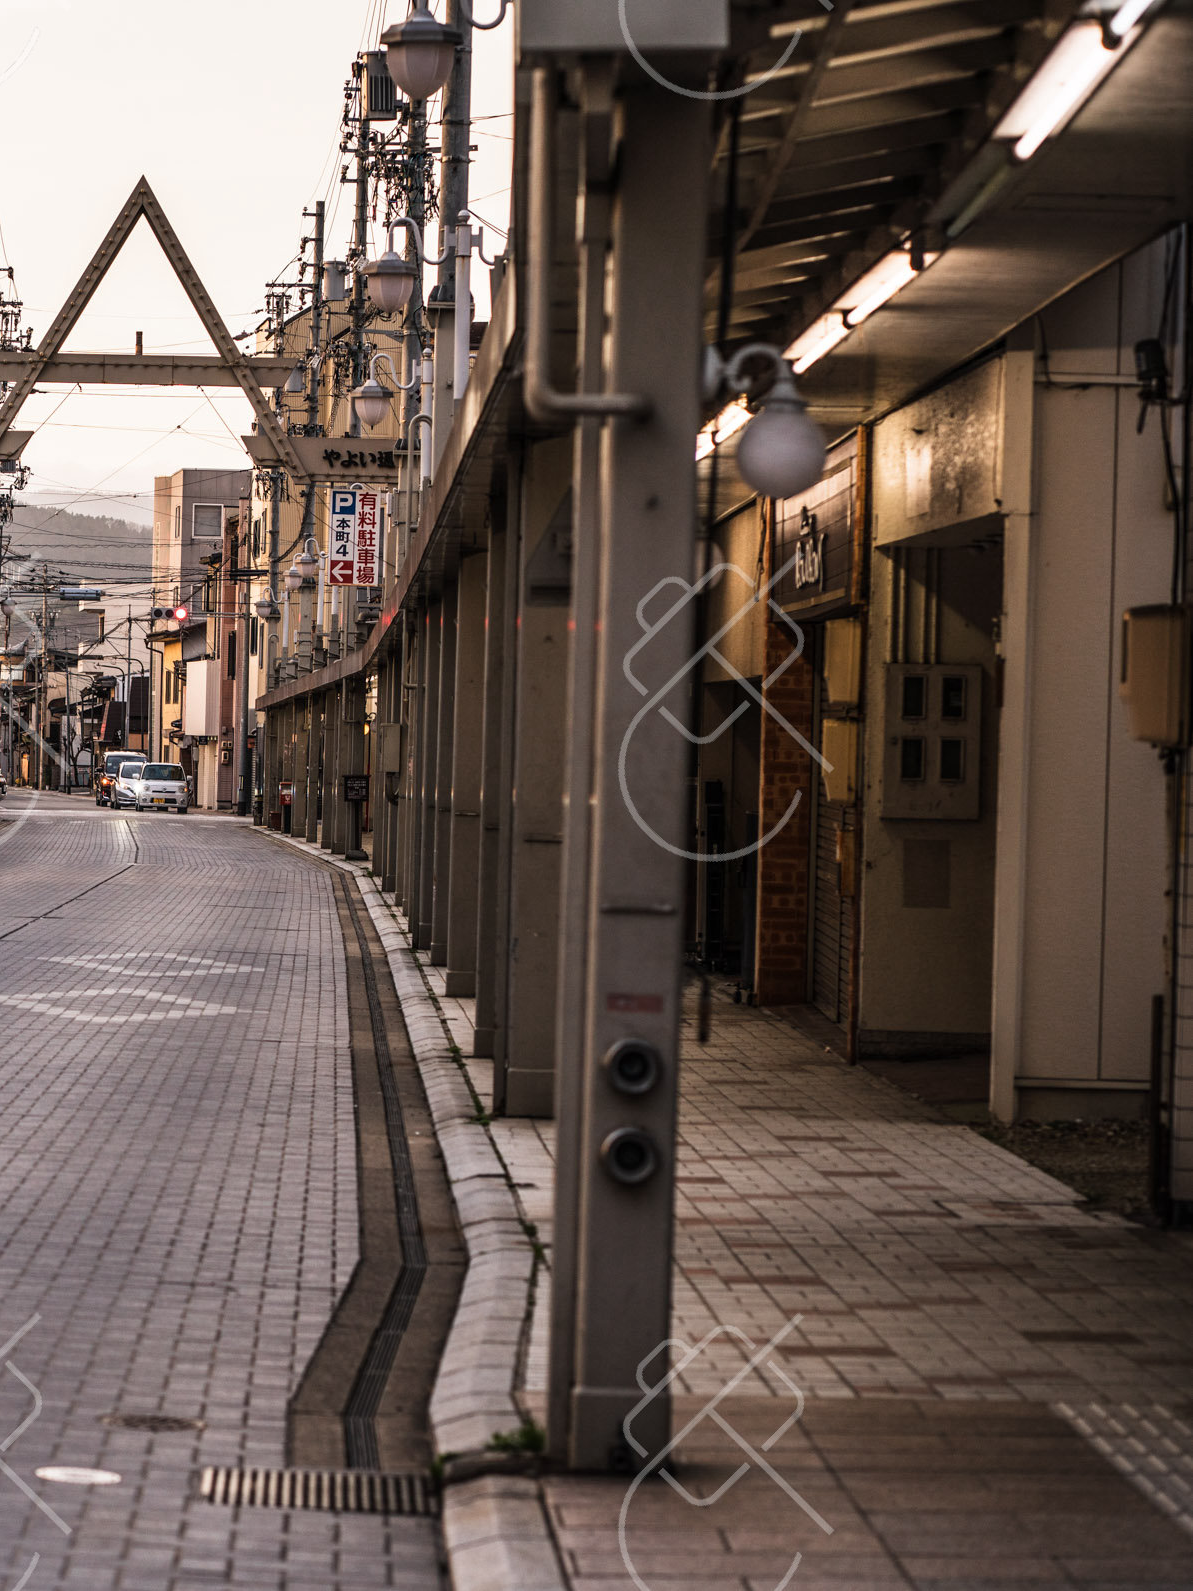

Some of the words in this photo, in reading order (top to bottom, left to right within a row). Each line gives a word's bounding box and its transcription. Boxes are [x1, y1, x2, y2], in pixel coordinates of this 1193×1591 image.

[335, 493, 354, 513] P
[335, 517, 351, 557] 本町4
[356, 491, 378, 585] 有料駐車場
